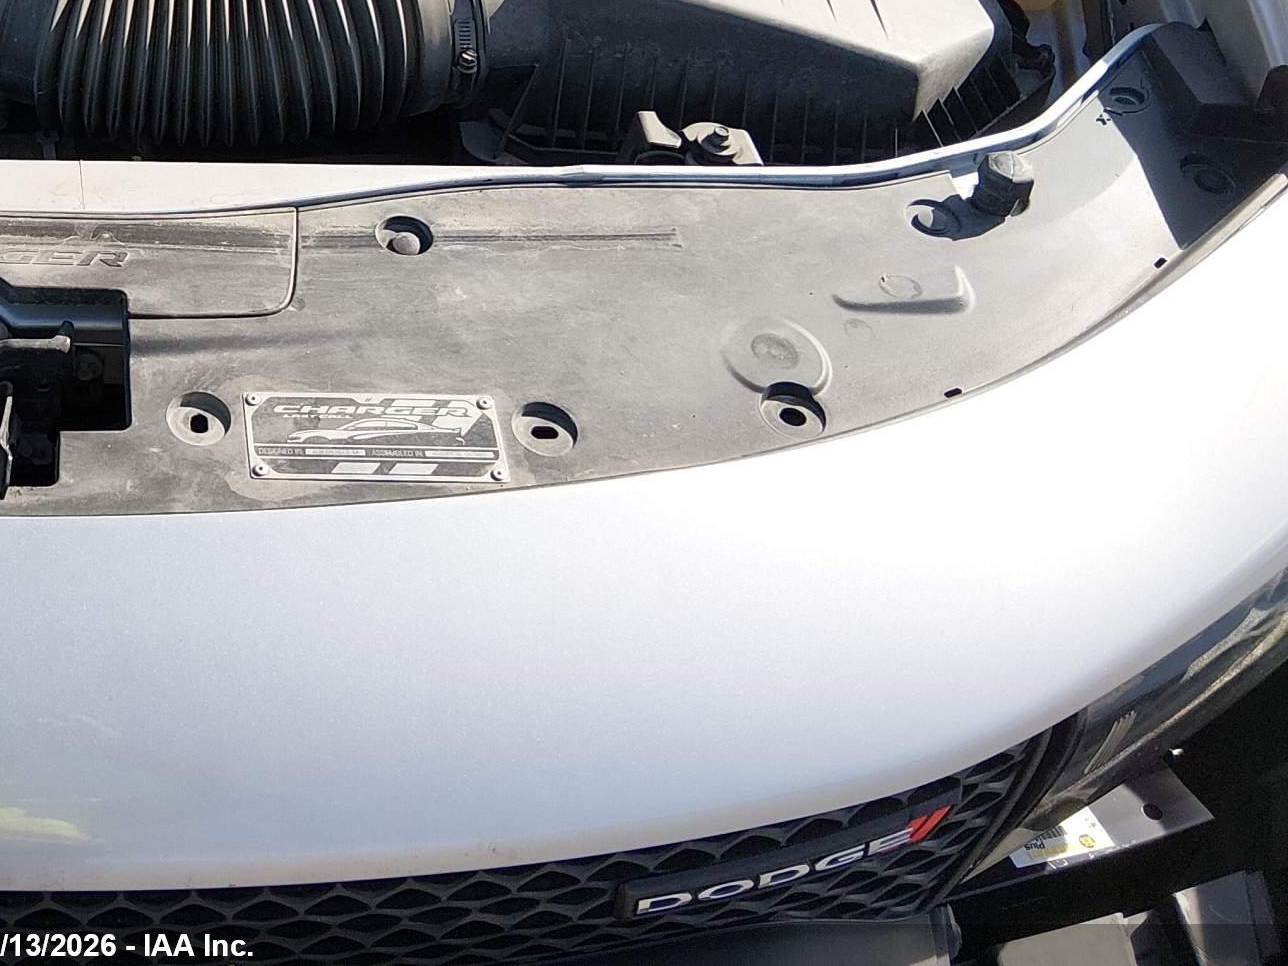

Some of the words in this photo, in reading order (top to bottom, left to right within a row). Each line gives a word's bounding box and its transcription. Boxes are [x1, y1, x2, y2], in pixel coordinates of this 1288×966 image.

[273, 404, 474, 417] CHARGER
[258, 447, 294, 455] DESIGNED
[636, 826, 914, 916] DODGE
